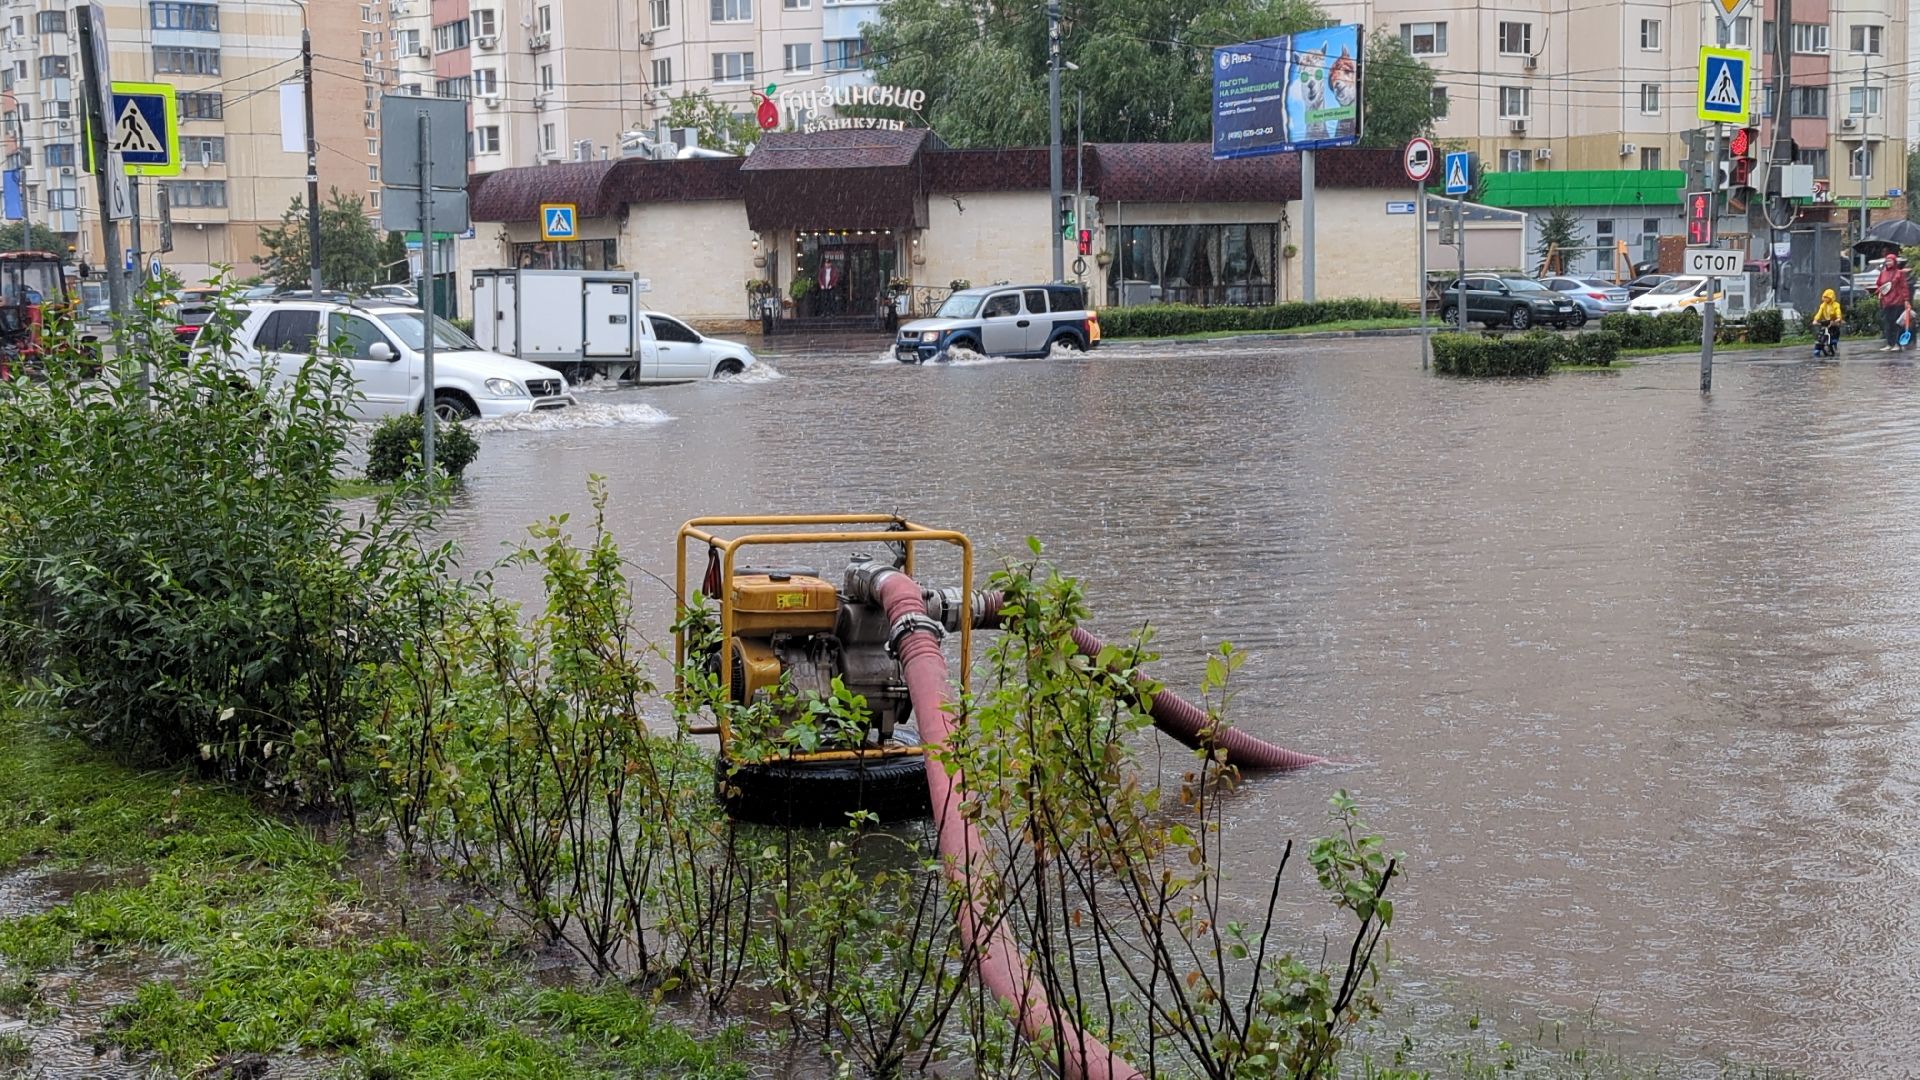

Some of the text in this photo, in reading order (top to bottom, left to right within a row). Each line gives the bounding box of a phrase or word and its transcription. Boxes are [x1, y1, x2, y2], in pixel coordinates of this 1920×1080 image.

[1231, 53, 1252, 64] Russ
[1219, 77, 1249, 88] ЛЬГОТЫ
[1219, 80, 1280, 98] НА РАЗМЕЩЕНИЕ
[780, 85, 926, 120] Грузинские
[1693, 255, 1737, 271] СТОП
